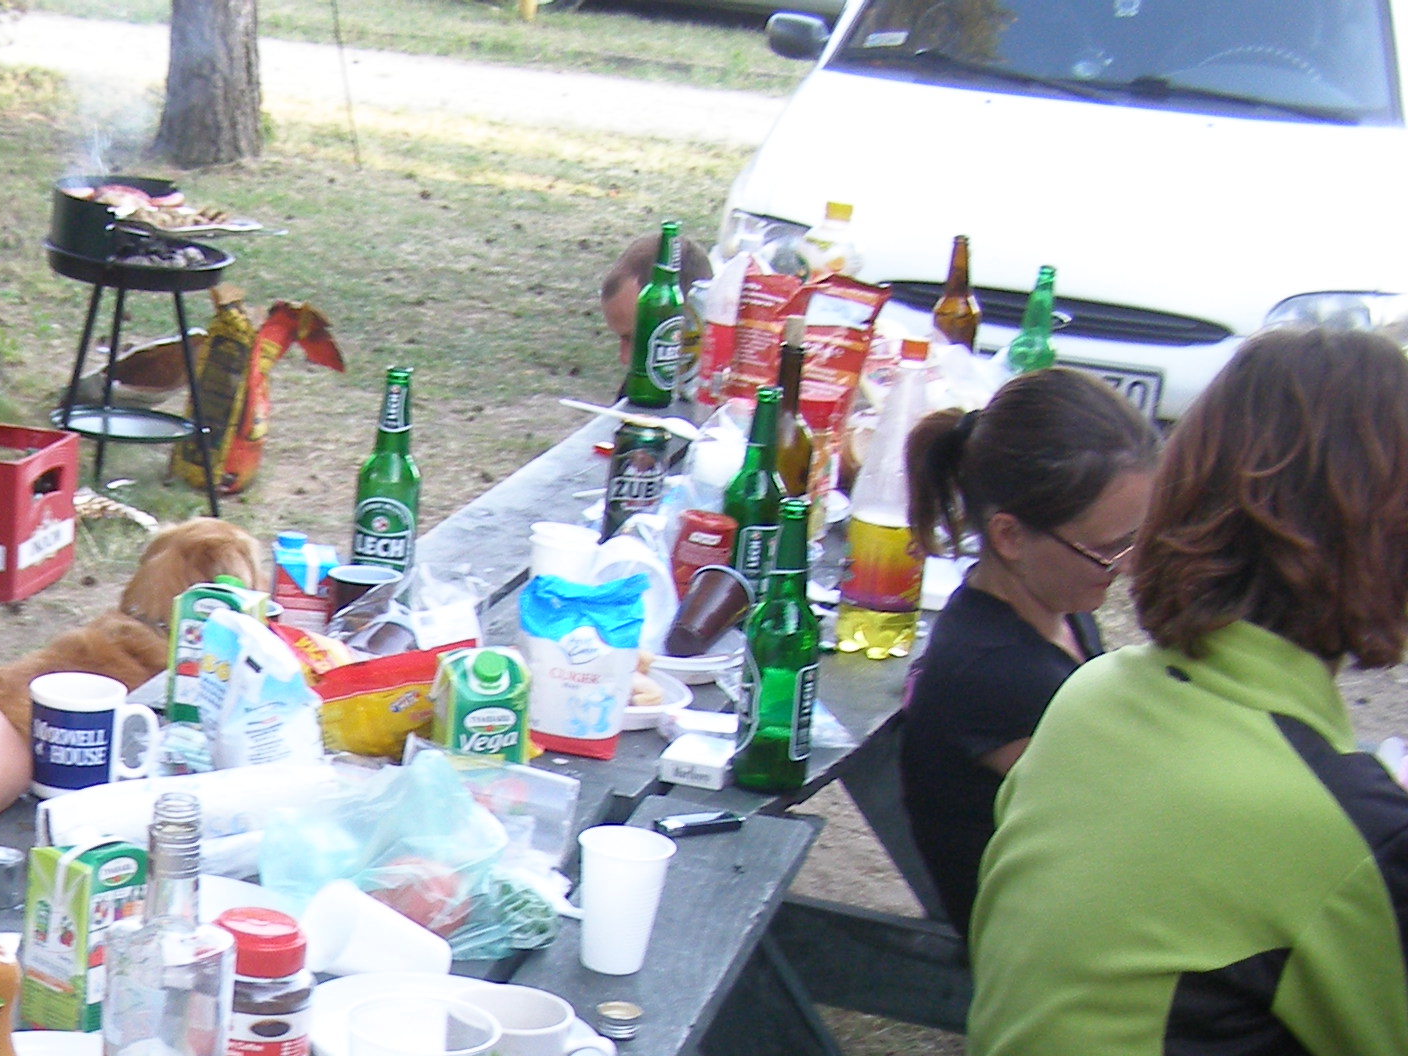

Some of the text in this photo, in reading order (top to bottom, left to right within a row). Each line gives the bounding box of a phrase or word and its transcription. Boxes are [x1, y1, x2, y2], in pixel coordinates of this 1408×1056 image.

[355, 533, 406, 558] LECH
[459, 730, 519, 754] Vega
[50, 744, 107, 766] HOUSE
